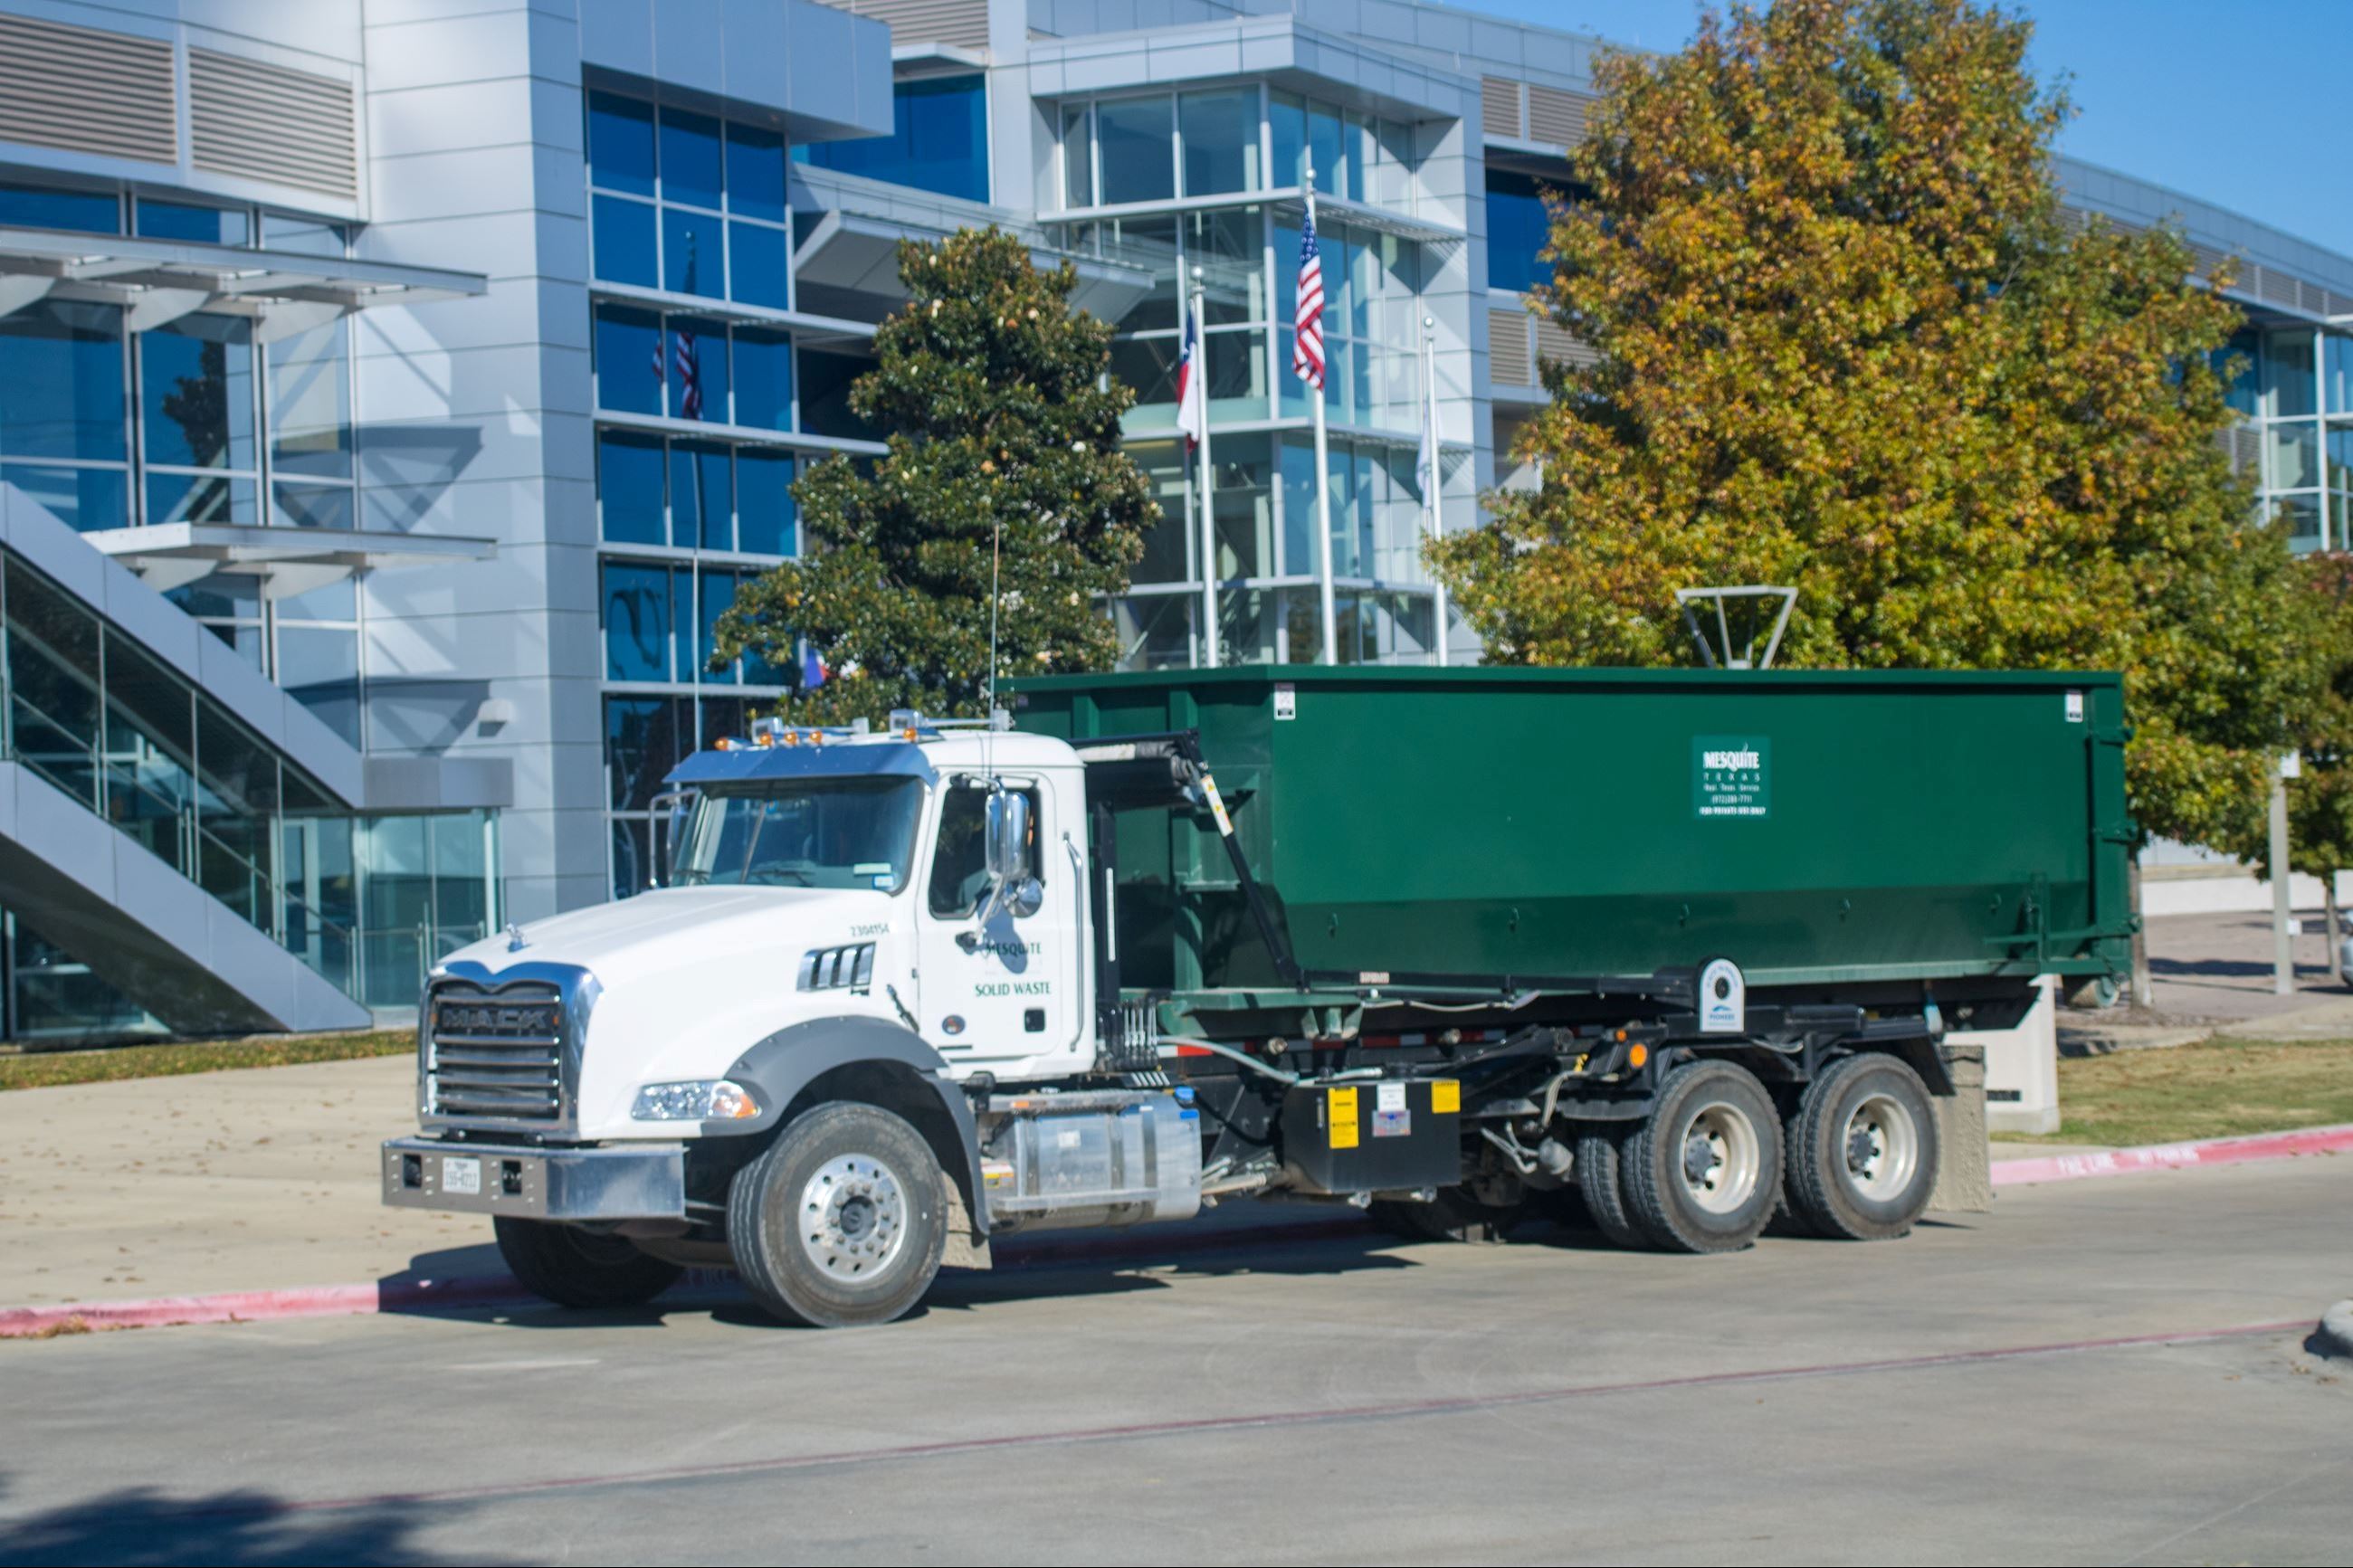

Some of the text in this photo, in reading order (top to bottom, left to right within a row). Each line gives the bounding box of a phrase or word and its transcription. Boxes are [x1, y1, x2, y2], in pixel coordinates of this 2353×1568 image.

[1703, 743, 1760, 772] MESQUITE
[975, 981, 1051, 997] SOLID WASTE
[443, 1009, 547, 1029] MACK
